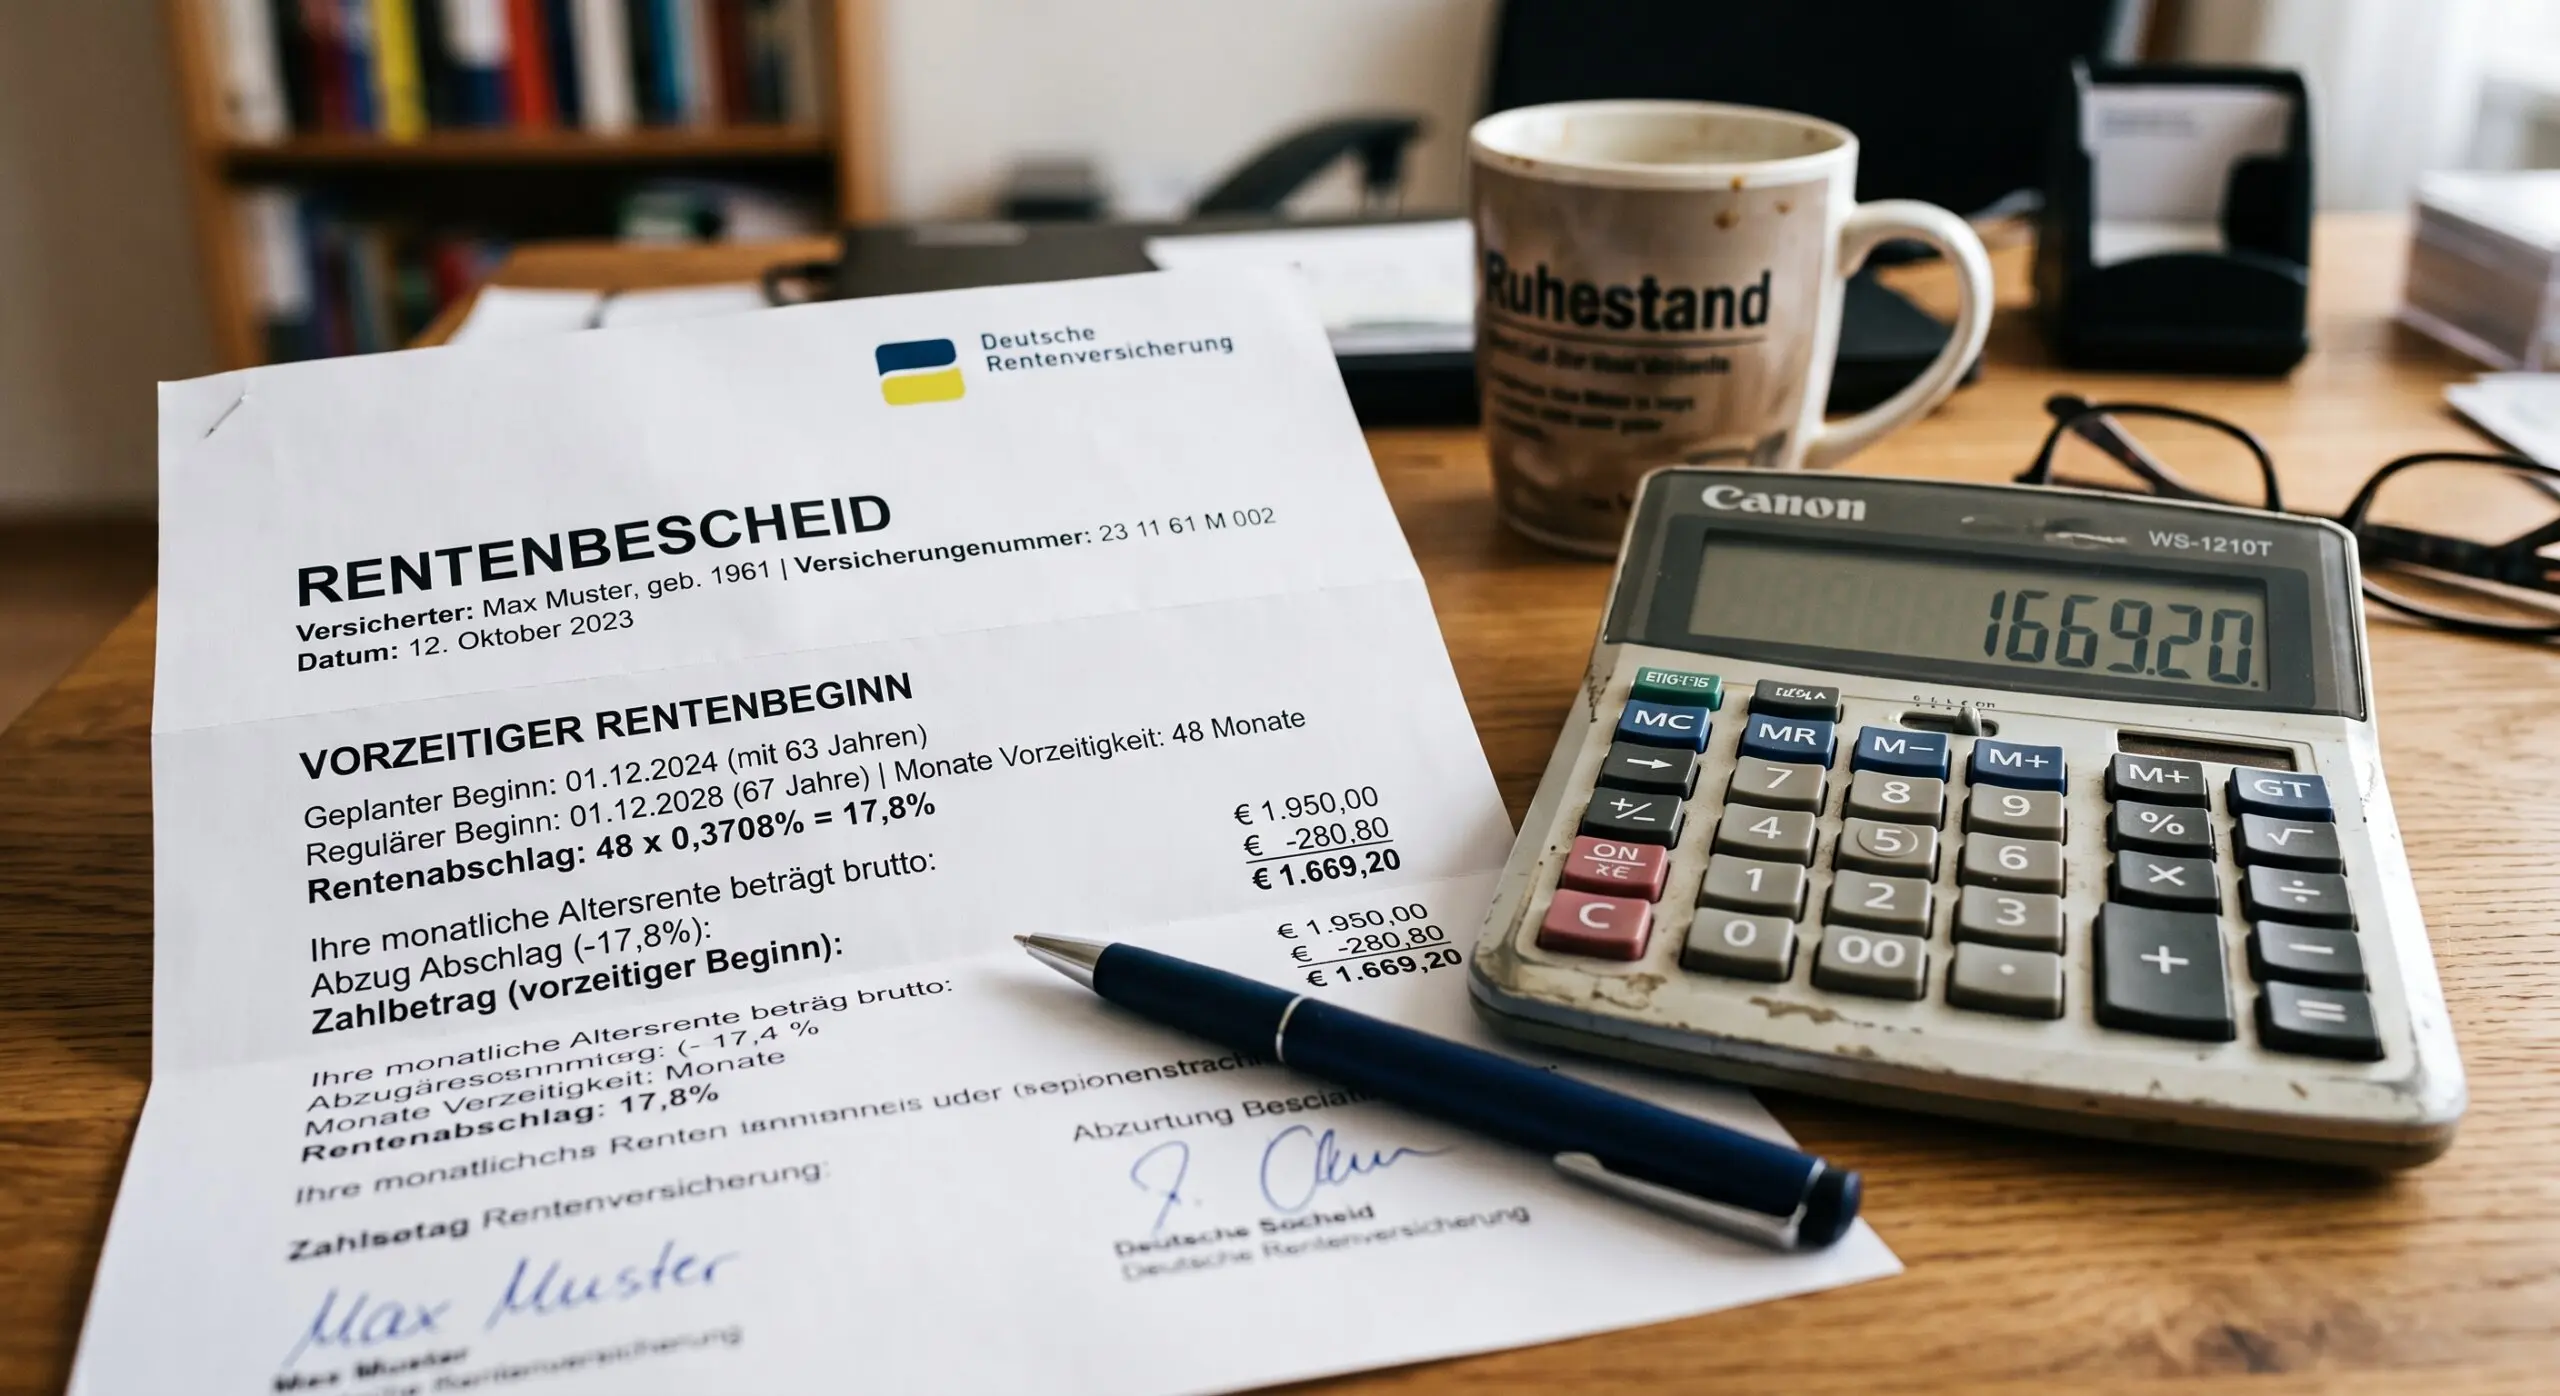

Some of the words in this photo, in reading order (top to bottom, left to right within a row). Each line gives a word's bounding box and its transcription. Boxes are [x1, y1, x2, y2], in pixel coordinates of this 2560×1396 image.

[1485, 251, 1771, 332] Ruhestand
[980, 325, 1096, 351] Deutsche
[985, 336, 1234, 373] Rentenversicherung
[1701, 484, 1866, 521] Canon
[297, 494, 892, 608] RENTENBESCHEID
[2148, 530, 2273, 557] WS-1210T
[295, 605, 474, 643] Versicherter:
[482, 597, 538, 618] Max
[545, 583, 639, 610] Muster,
[647, 571, 702, 600] geb.
[710, 559, 769, 585] 1961
[792, 530, 1092, 574] Versicherungenummer:
[1098, 522, 1129, 543] 23
[1136, 519, 1160, 538] 11
[1168, 515, 1196, 535] 61
[1203, 511, 1227, 531] M
[1232, 506, 1276, 528] 002
[297, 645, 398, 673] Datum:
[409, 636, 448, 657] 12.
[457, 623, 562, 651] Oktober
[569, 609, 635, 636] 2023
[298, 715, 586, 780] VORZEITIGER
[595, 671, 913, 741] RENTENBEGINN
[1634, 709, 1695, 731] MC
[1758, 723, 1817, 746] MR
[303, 793, 444, 830] Geplanter
[452, 778, 557, 809] Beginn:
[565, 750, 719, 793] 01.12.2024
[727, 743, 779, 776] (mit
[785, 737, 819, 762] 63
[827, 722, 928, 757] Jahren)
[1765, 766, 1794, 790] 7
[1989, 749, 2050, 769] M+
[2129, 764, 2190, 784] M+
[306, 829, 447, 867] Regulärer
[454, 813, 561, 845] Beginn:
[569, 785, 724, 828] 01.12.2028
[733, 777, 775, 810] (67
[785, 764, 870, 797] Jahre)
[893, 751, 994, 783] Monate
[998, 727, 1165, 768] Vorzeitigkeit:
[1171, 720, 1205, 744] 48
[1210, 709, 1306, 739] Monate
[1233, 803, 1254, 826] €
[1261, 785, 1379, 822] 1.950,00
[1881, 781, 1911, 804] 8
[2001, 795, 2031, 817] 9
[2254, 778, 2311, 799] GT
[307, 845, 586, 905] Rentenabschlag:
[595, 833, 634, 860] 48
[641, 834, 664, 855] x
[671, 808, 805, 854] 0,3708%
[813, 810, 833, 825] =
[843, 790, 936, 827] 17,8%
[1242, 834, 1264, 857] €
[1285, 816, 1389, 851] -280,80
[1748, 817, 1783, 840] 4
[1873, 829, 1903, 852] 5
[1251, 866, 1273, 891] €
[1279, 848, 1401, 887] 1.669,20
[1592, 843, 1639, 861] ON
[1998, 846, 2028, 871] 6
[1744, 867, 1763, 892] 1
[1864, 882, 1896, 910] 2
[311, 936, 371, 963] Ihre
[381, 907, 550, 952] monatliche
[557, 881, 721, 926] Altersrente
[729, 862, 836, 900] beträgt
[842, 851, 936, 883] brutto:
[1276, 922, 1299, 940] €
[1306, 902, 1429, 936] 1.950,00
[1579, 901, 1616, 930] C
[1996, 898, 2027, 926] 3
[1289, 944, 1313, 963] €
[1337, 924, 1445, 955] -280,80
[1722, 919, 1758, 947] 0
[1838, 934, 1907, 968] 00
[310, 965, 411, 999] Abzug
[419, 942, 563, 983] Abschlag
[573, 916, 711, 965] (-17,8%):
[1305, 969, 1329, 988] €
[1335, 948, 1463, 983] 1.669,20
[311, 988, 497, 1036] Zahlbetrag
[508, 957, 697, 1011] (vorzeitiger
[705, 932, 843, 975] Beginn):
[311, 1068, 374, 1088] Ihre
[385, 1039, 561, 1078] monatliche
[569, 1011, 741, 1049] Altersrente
[750, 995, 848, 1021] beträg
[856, 979, 953, 1005] brutto:
[677, 1038, 701, 1059] (-
[713, 1025, 779, 1049] 17,4
[789, 1019, 820, 1038] %
[304, 1106, 431, 1138] Monate
[442, 1070, 653, 1115] Verzeitigkeit:
[665, 1051, 786, 1081] Monate
[300, 1103, 605, 1164] Rentenabschlag:
[619, 1082, 720, 1114] 17,8%
[295, 1183, 361, 1205] Ihre
[610, 1125, 728, 1155] Renten
[280, 1286, 453, 1370] Max
[483, 1238, 742, 1332] Muster
